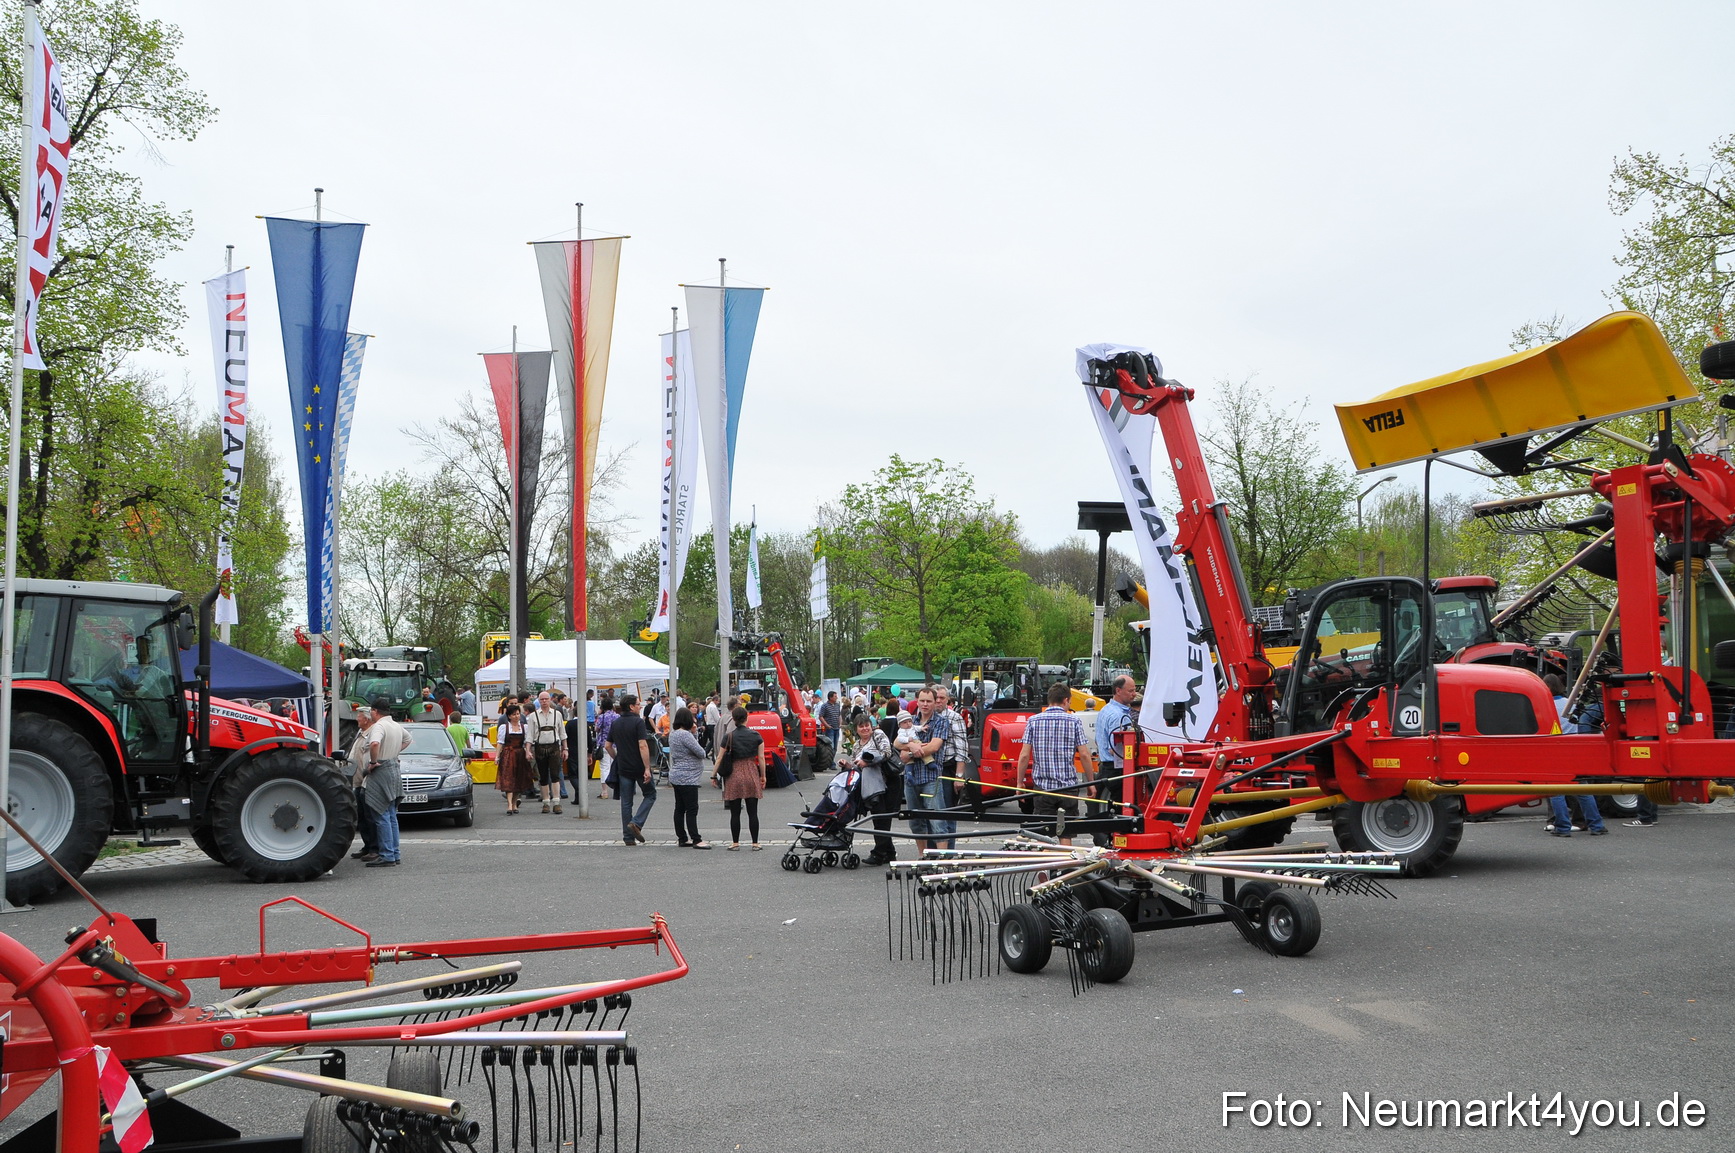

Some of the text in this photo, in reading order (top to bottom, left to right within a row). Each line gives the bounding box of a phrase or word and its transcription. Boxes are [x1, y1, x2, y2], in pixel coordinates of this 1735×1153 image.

[1362, 408, 1405, 433] FELLA
[1206, 546, 1224, 598] WEIDEMANN
[1346, 653, 1371, 662] CASE
[222, 709, 259, 722] FERGUSON
[1405, 710, 1419, 724] 20
